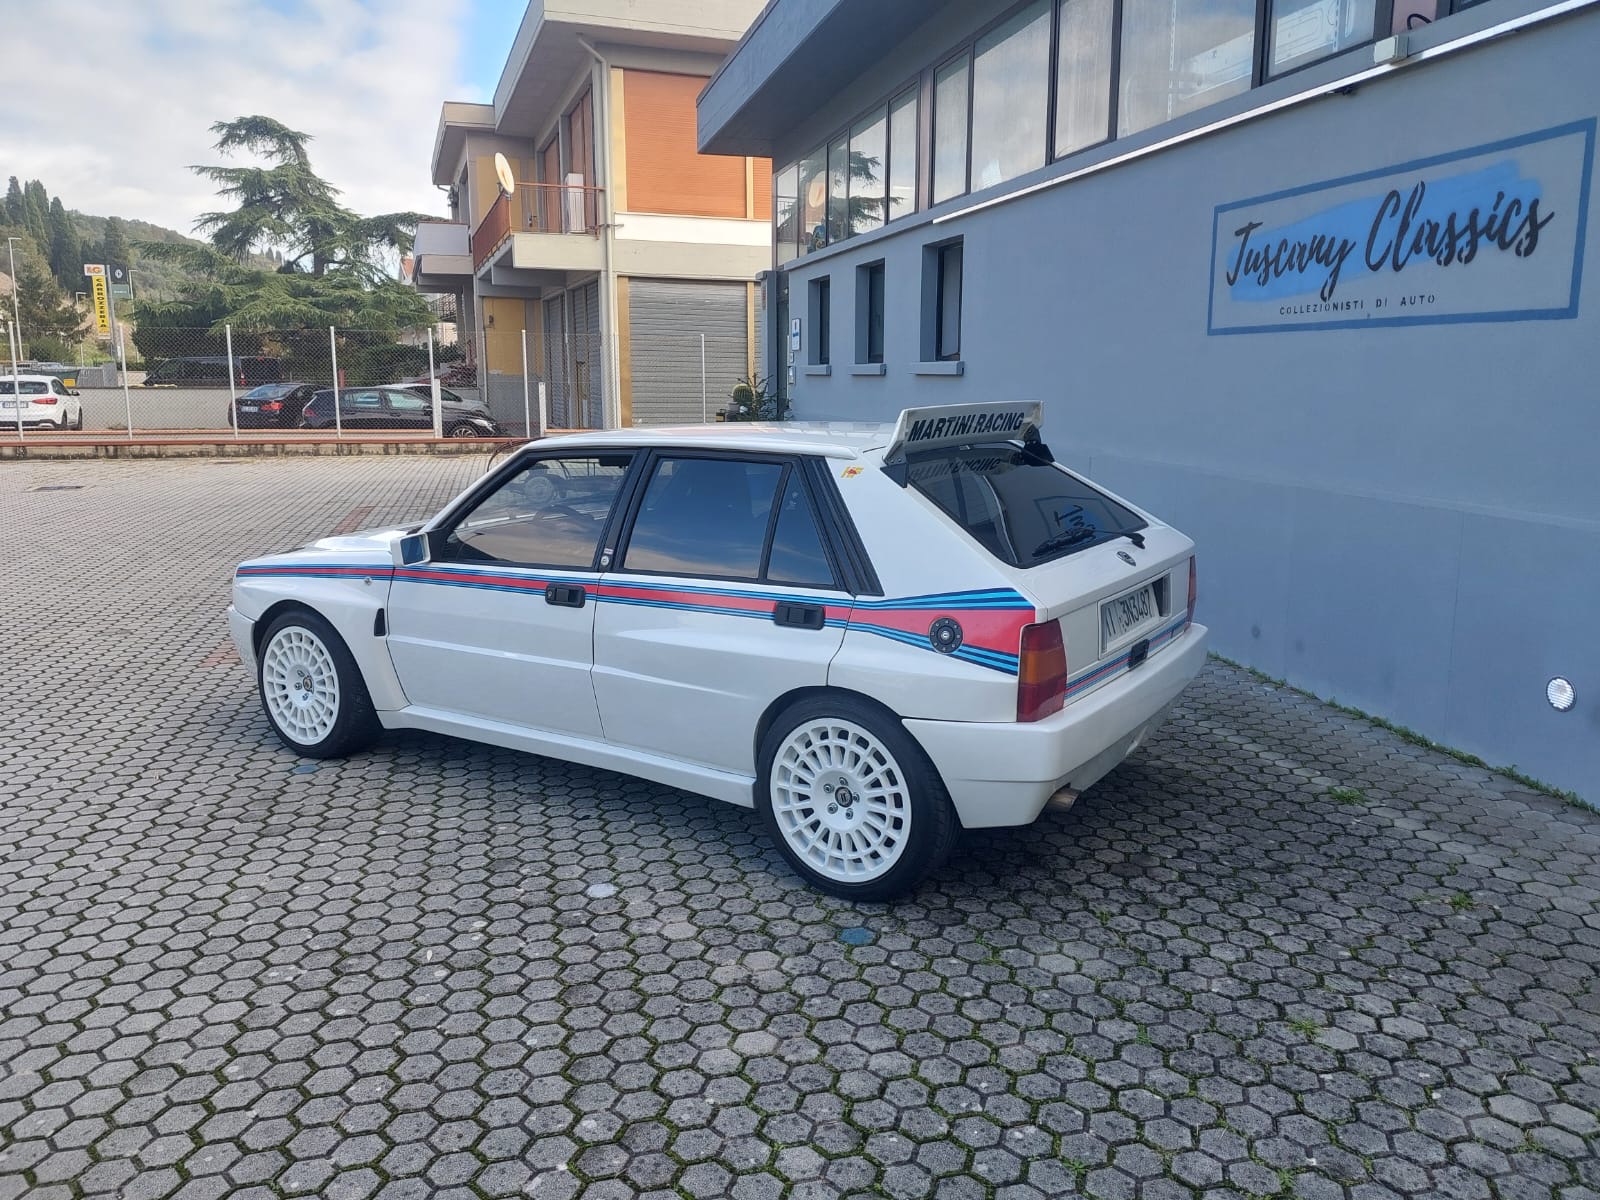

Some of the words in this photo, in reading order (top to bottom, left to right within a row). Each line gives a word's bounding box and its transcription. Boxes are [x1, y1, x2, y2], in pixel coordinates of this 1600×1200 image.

[1226, 221, 1356, 302] Tuscany
[1366, 181, 1555, 273] Classics
[95, 278, 107, 328] CARROZZERIA
[1279, 299, 1364, 315] COLLEZIONISTI
[1375, 298, 1388, 308] DI
[1400, 295, 1435, 307] AUTO
[907, 414, 976, 442] MARTINI
[973, 412, 1025, 434] RACING
